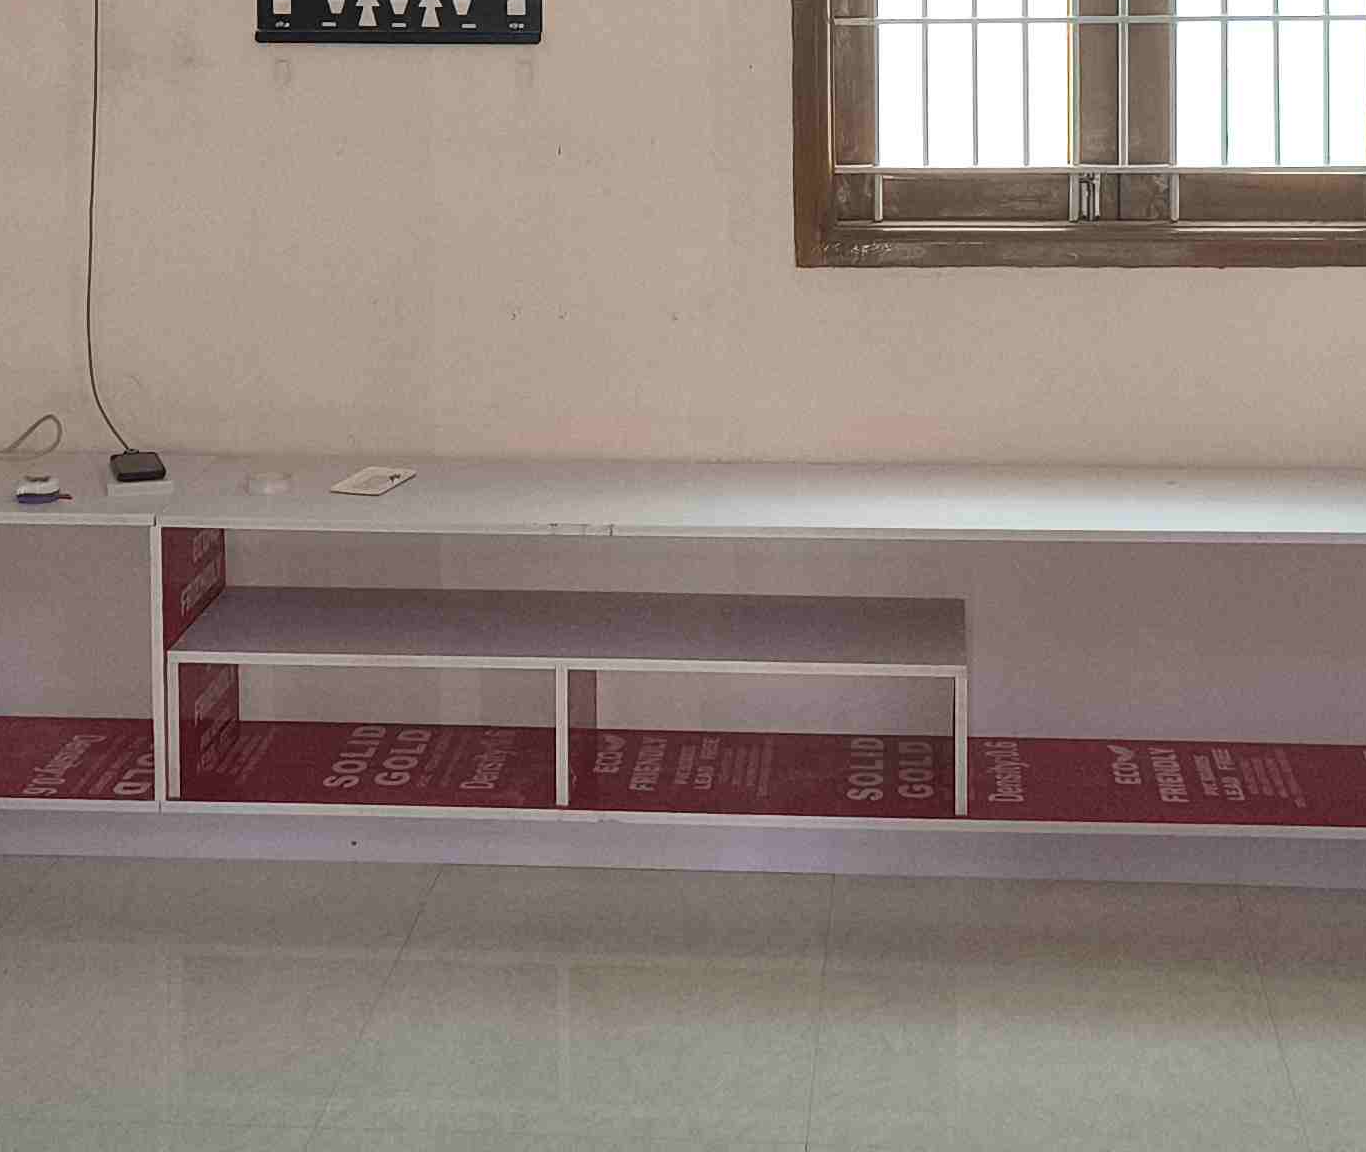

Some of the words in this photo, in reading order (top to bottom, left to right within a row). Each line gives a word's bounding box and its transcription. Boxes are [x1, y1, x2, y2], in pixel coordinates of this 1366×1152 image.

[322, 725, 386, 789] SOLID
[374, 727, 433, 787] GOLD
[846, 737, 885, 801] SOLID
[897, 740, 935, 799] GOLD
[1147, 747, 1190, 804] FRIENDLY
